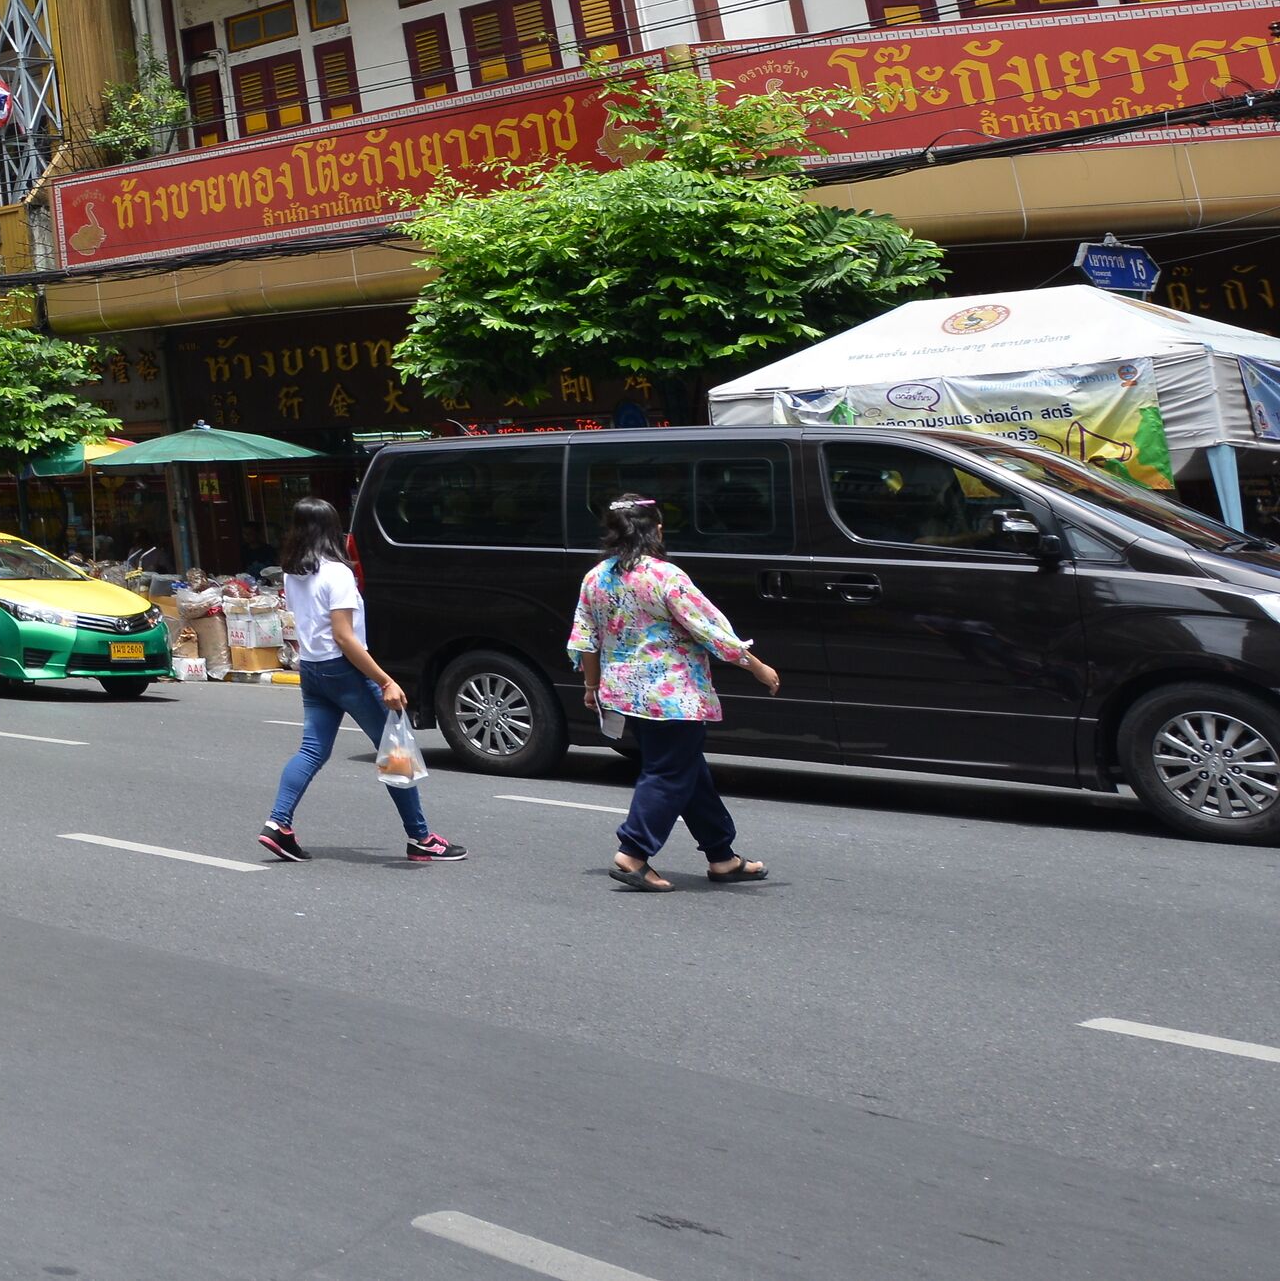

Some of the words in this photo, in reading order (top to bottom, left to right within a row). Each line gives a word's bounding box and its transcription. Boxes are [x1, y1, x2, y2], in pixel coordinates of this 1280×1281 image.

[738, 59, 809, 83] ตราหัวช้าง
[262, 186, 384, 228] สำนักงานใหญ่
[1088, 254, 1126, 270] เยาวราช
[1130, 258, 1147, 281] 15
[1040, 402, 1074, 421] สตรี
